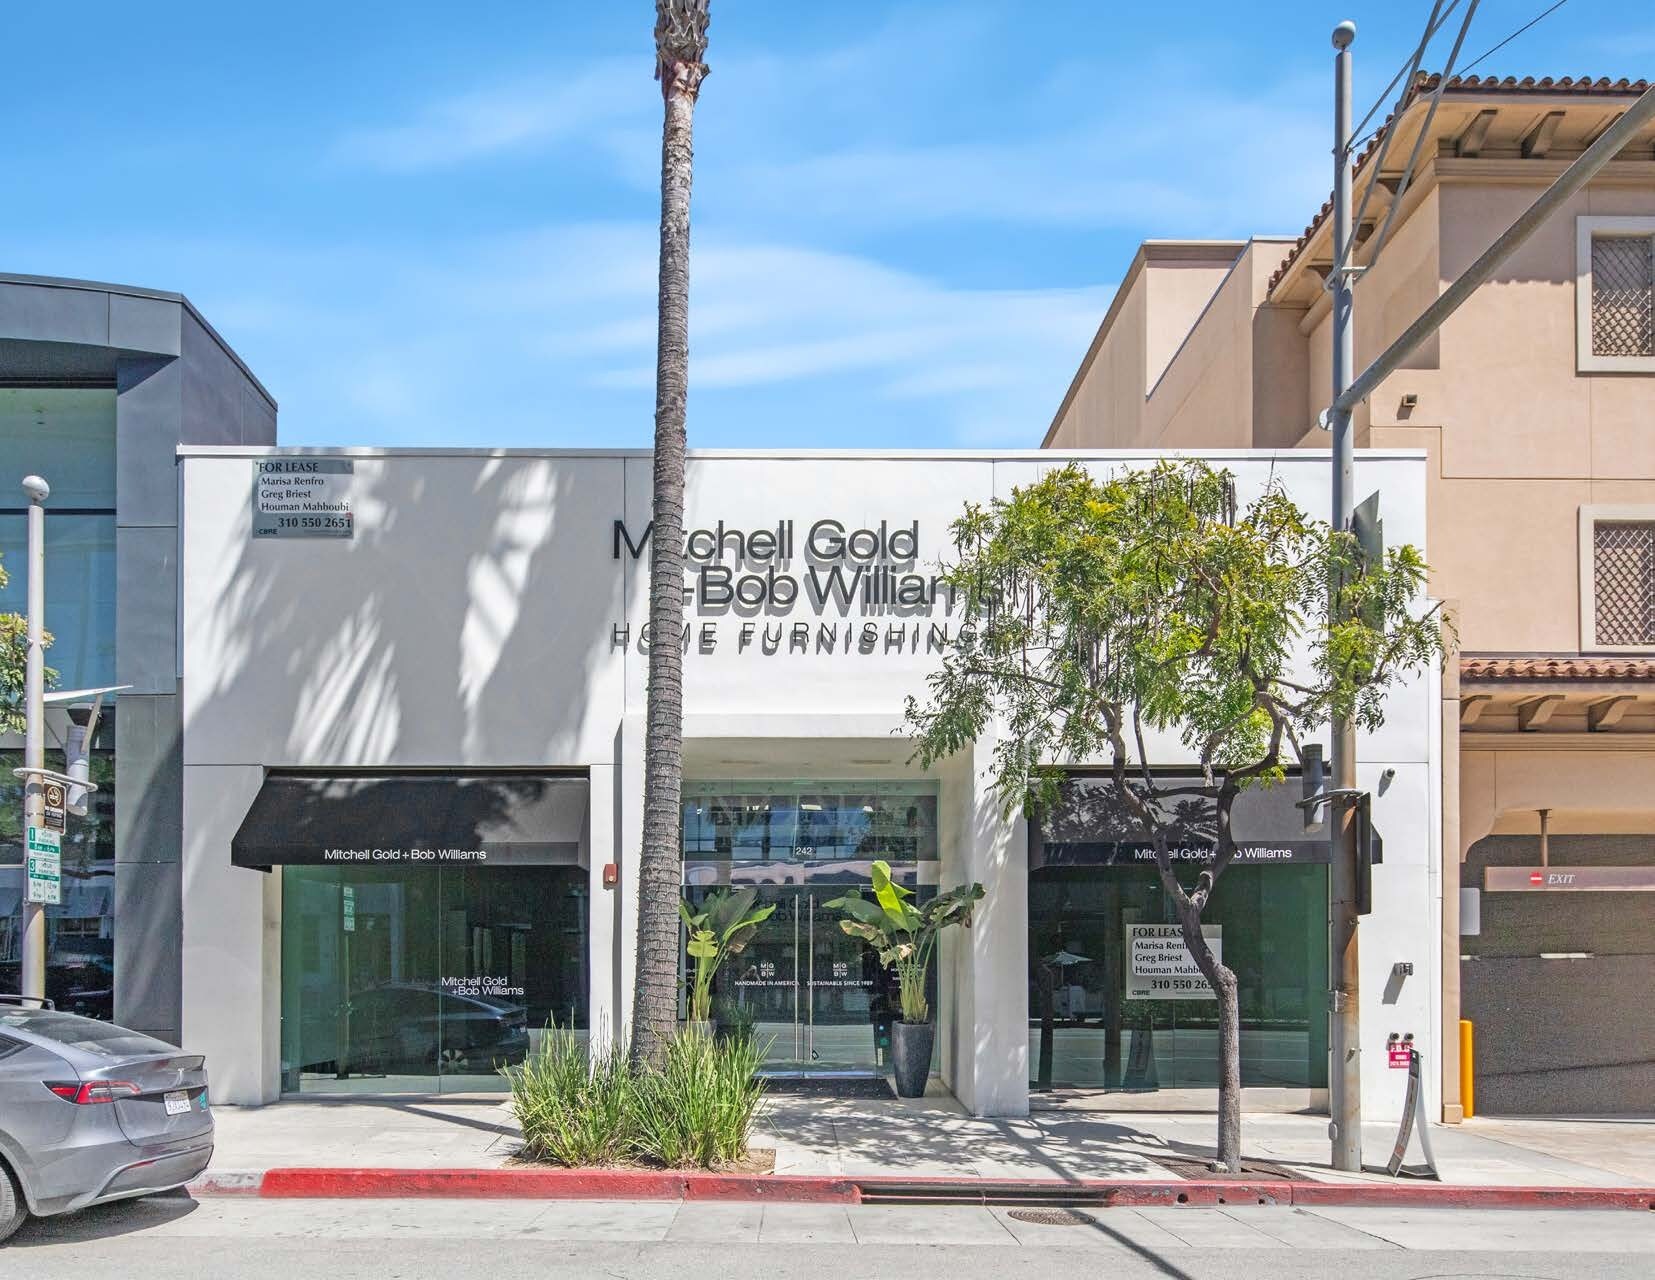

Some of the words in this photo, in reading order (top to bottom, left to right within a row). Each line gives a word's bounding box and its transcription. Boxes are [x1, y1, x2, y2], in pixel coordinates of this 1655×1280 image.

[259, 462, 282, 473] FOR
[286, 462, 319, 473] LEASE
[260, 476, 291, 486] Marisa
[294, 476, 324, 486] Renfro
[261, 489, 284, 500] Greg
[286, 489, 311, 498] Briest
[261, 502, 300, 511] Houman
[302, 502, 349, 511] Mahboubi
[278, 517, 298, 528] 310
[301, 517, 321, 528] 550
[324, 517, 351, 528] 2651
[613, 519, 793, 559] Mchell
[808, 519, 918, 559] Gold
[613, 622, 717, 644] HE
[324, 849, 370, 860] Mitchell
[372, 849, 400, 860] Gold
[438, 849, 487, 860] Williams
[795, 846, 812, 856] 242
[1134, 849, 1179, 859] Mitcell
[1180, 848, 1208, 859] Gold
[1245, 847, 1292, 859] Williams
[1547, 873, 1576, 885] EXIT
[1132, 927, 1155, 937] FOR
[1158, 927, 1184, 937] LEAS
[1135, 942, 1164, 950] Marisa
[1166, 941, 1188, 950] Renf
[1135, 953, 1156, 964] Greg
[1158, 953, 1182, 962] Briest
[1135, 965, 1172, 974] Houman
[1174, 965, 1201, 974] Mahb
[441, 976, 480, 986] Mitchell
[482, 976, 508, 986] Gold
[1151, 980, 1170, 990] 310
[1173, 980, 1192, 990] 550
[1194, 980, 1211, 990] 26
[481, 986, 524, 996] Williams
